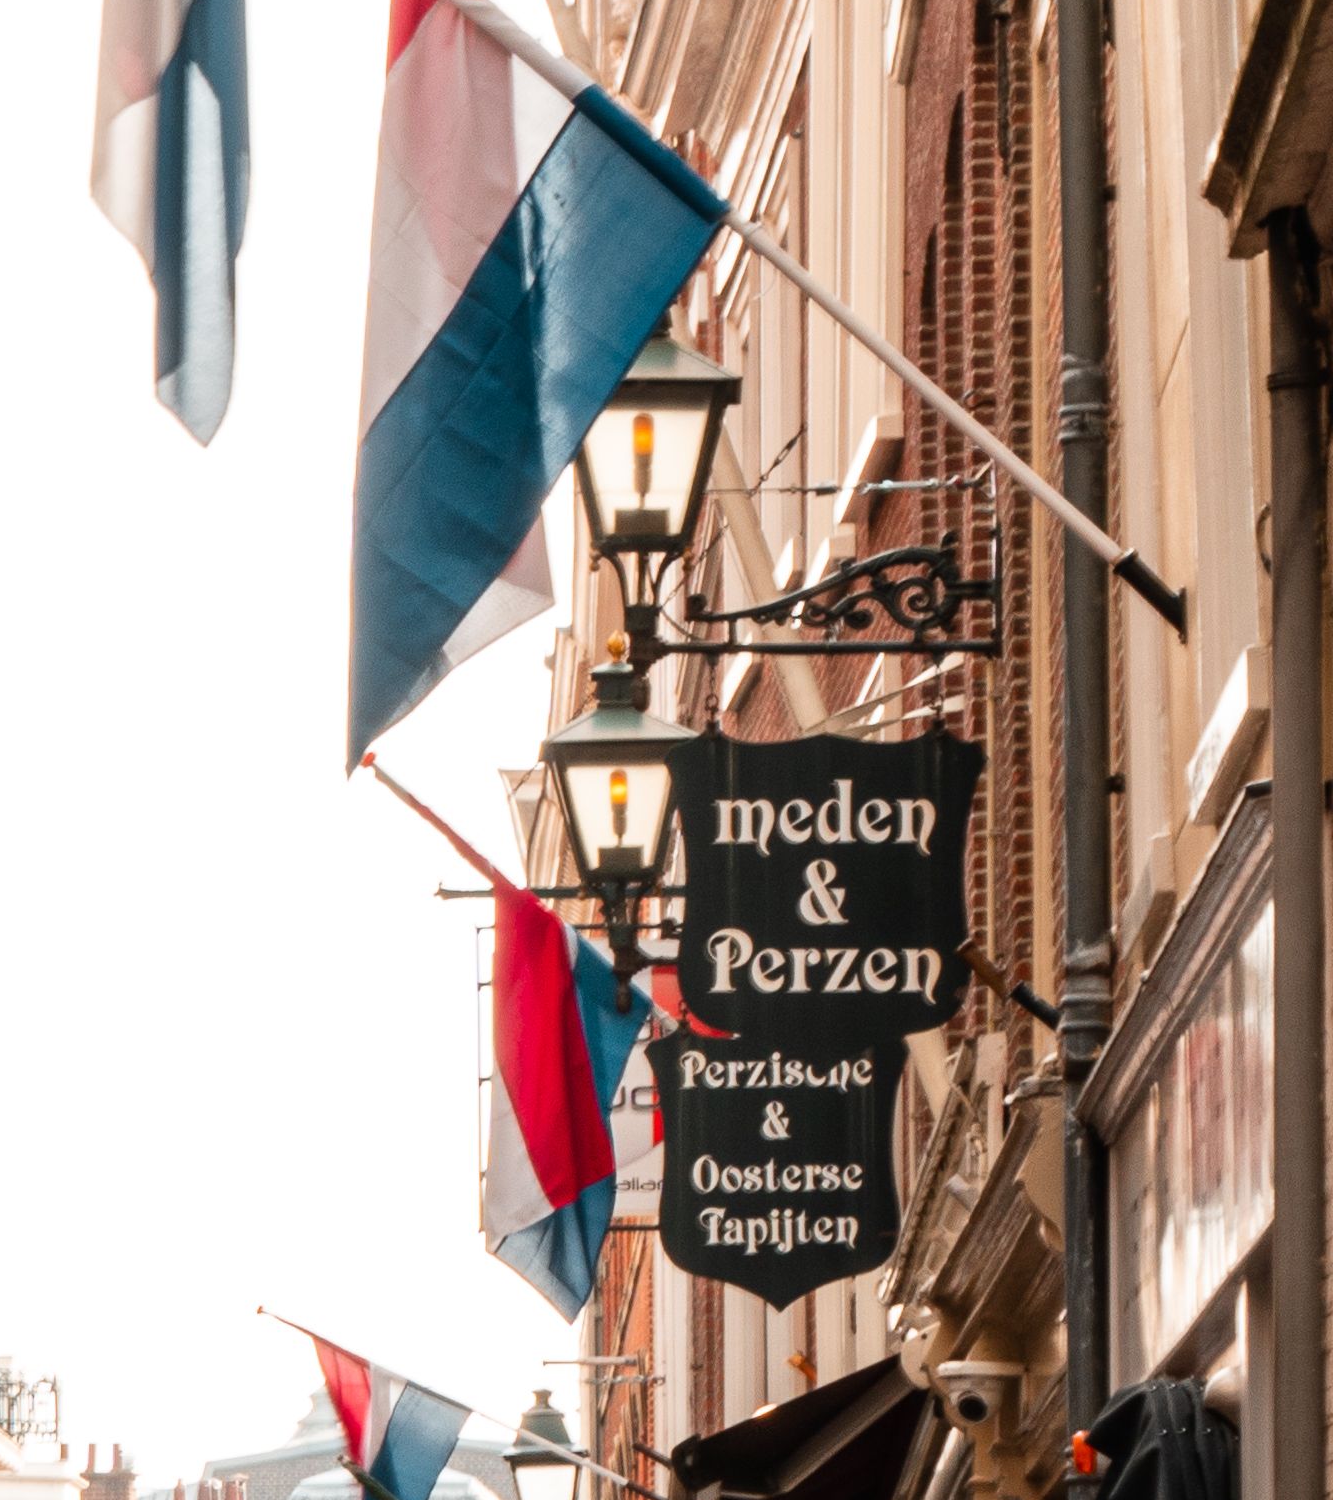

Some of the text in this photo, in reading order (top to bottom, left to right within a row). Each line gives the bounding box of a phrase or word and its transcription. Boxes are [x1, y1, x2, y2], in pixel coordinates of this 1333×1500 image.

[712, 779, 937, 856] meden
[797, 858, 849, 925] &
[707, 928, 942, 1004] Perzen
[760, 1100, 792, 1140] &
[691, 1154, 863, 1194] Oosterse
[698, 1206, 859, 1255] Tapijten
